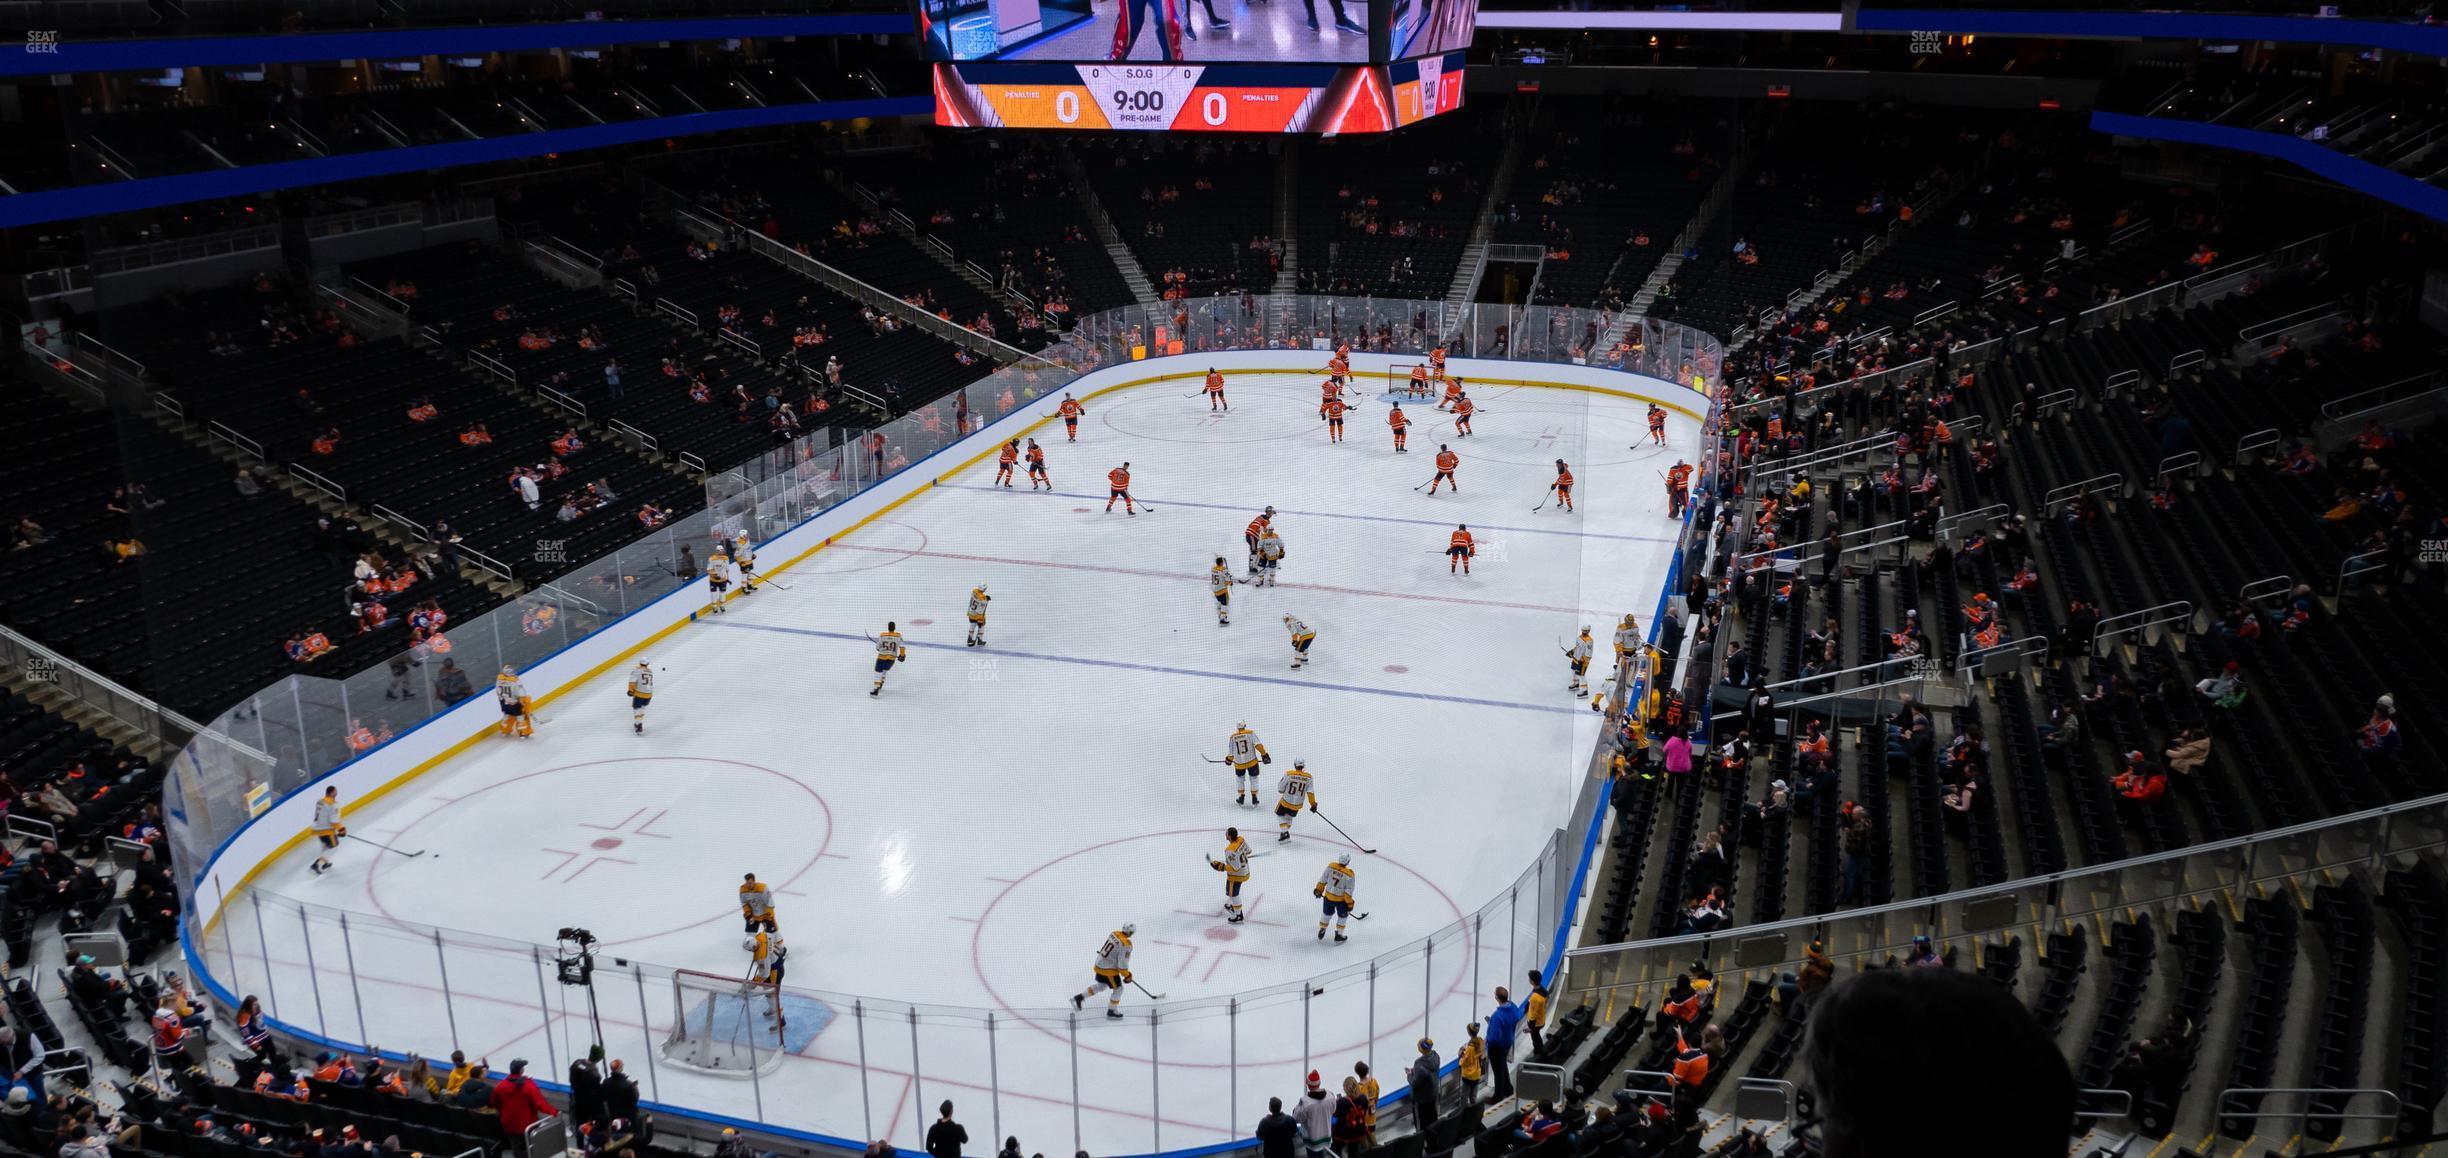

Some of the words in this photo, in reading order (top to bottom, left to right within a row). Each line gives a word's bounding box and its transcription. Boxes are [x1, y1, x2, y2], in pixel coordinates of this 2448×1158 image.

[1092, 68, 1100, 78] 0
[1183, 69, 1191, 79] 0
[1005, 91, 1040, 99] PENALTIES
[1113, 90, 1164, 111] 9:00
[1242, 94, 1280, 102] PENALTIES
[1055, 90, 1080, 124] 0
[1203, 92, 1228, 126] 0
[1120, 114, 1162, 122] PRE-GAME
[1235, 739, 1249, 755] 13
[1288, 780, 1306, 797] 64
[1332, 877, 1340, 888] 7
[1099, 939, 1115, 958] 19
